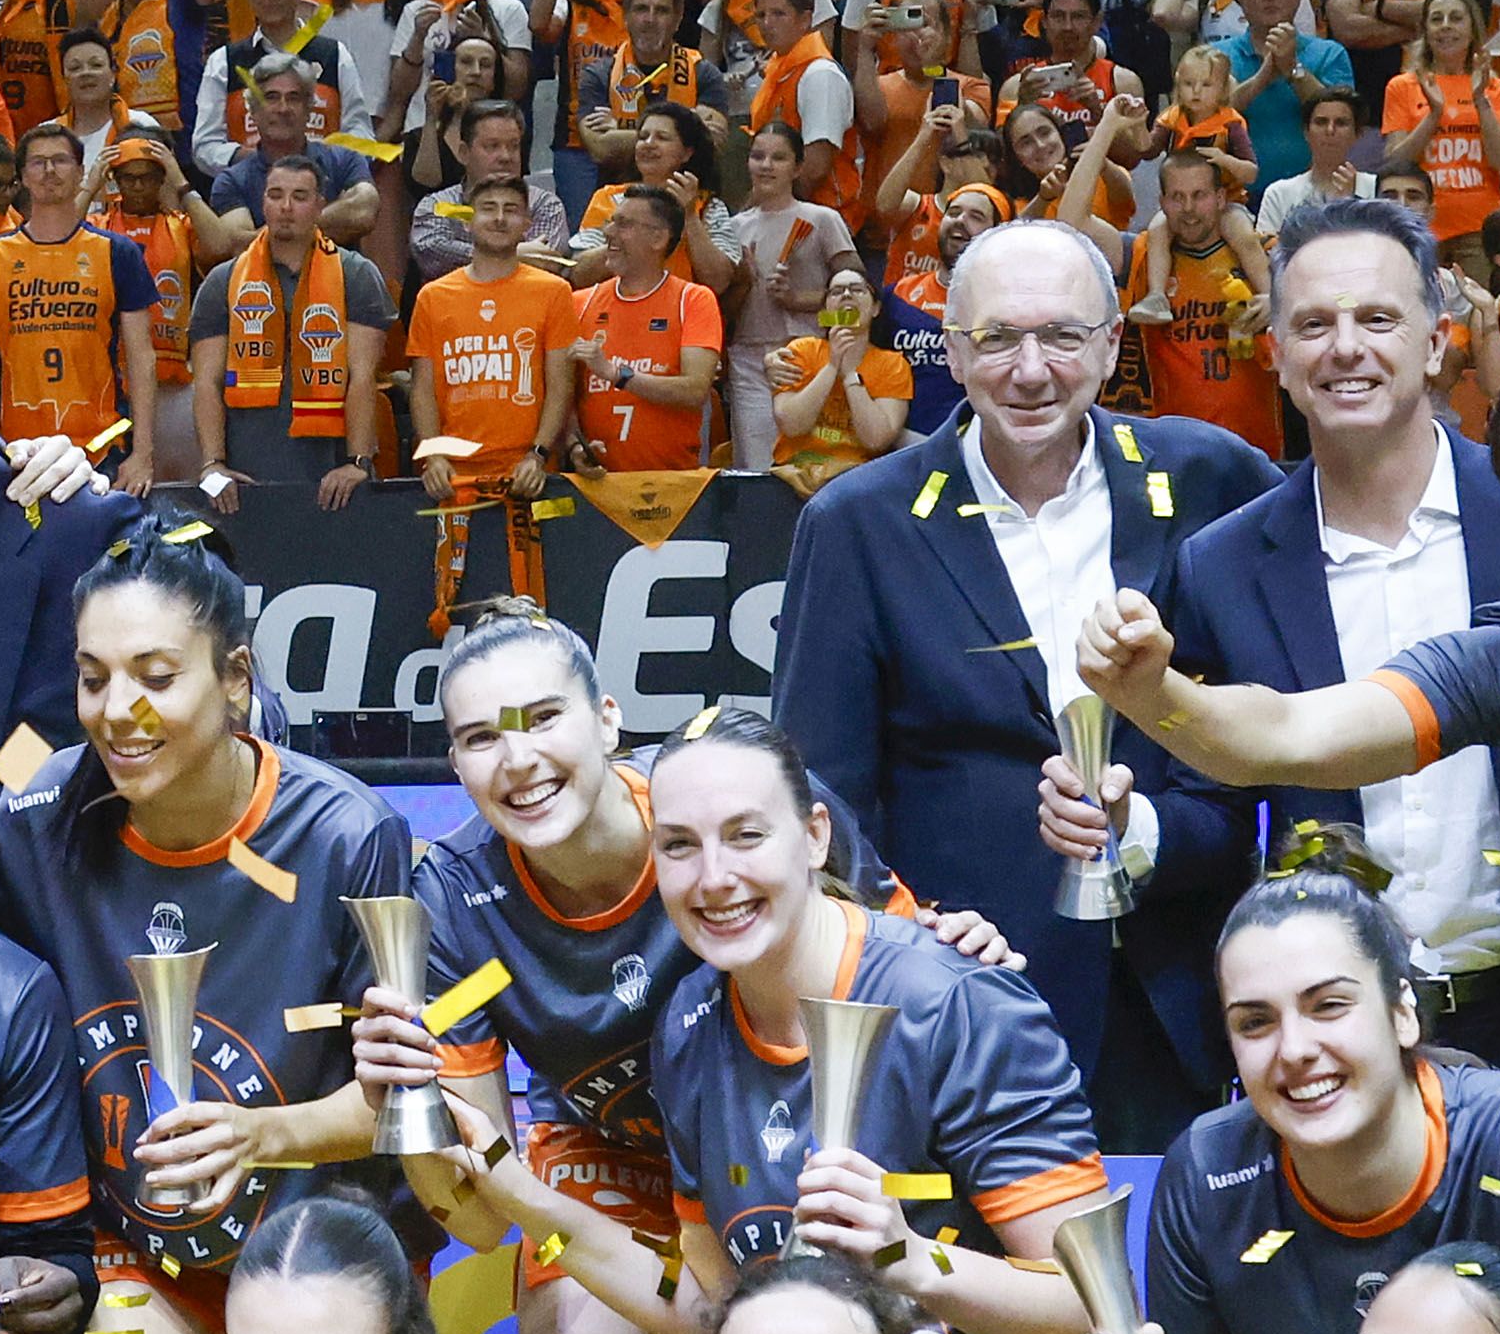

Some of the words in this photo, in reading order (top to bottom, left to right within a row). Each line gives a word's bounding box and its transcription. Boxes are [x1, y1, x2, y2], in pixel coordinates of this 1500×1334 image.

[1423, 138, 1483, 165] COPA
[8, 278, 80, 302] Cultura
[8, 301, 98, 321] Esfuerzo
[234, 341, 274, 359] VBC
[444, 341, 452, 356] A
[455, 336, 484, 353] PER
[488, 334, 509, 351] LA
[43, 348, 63, 383] 9
[300, 368, 344, 386] VBC
[445, 353, 514, 386] COPA!
[612, 405, 634, 442] 7
[6, 784, 61, 814] luanvi
[550, 1161, 669, 1201] PULEVA
